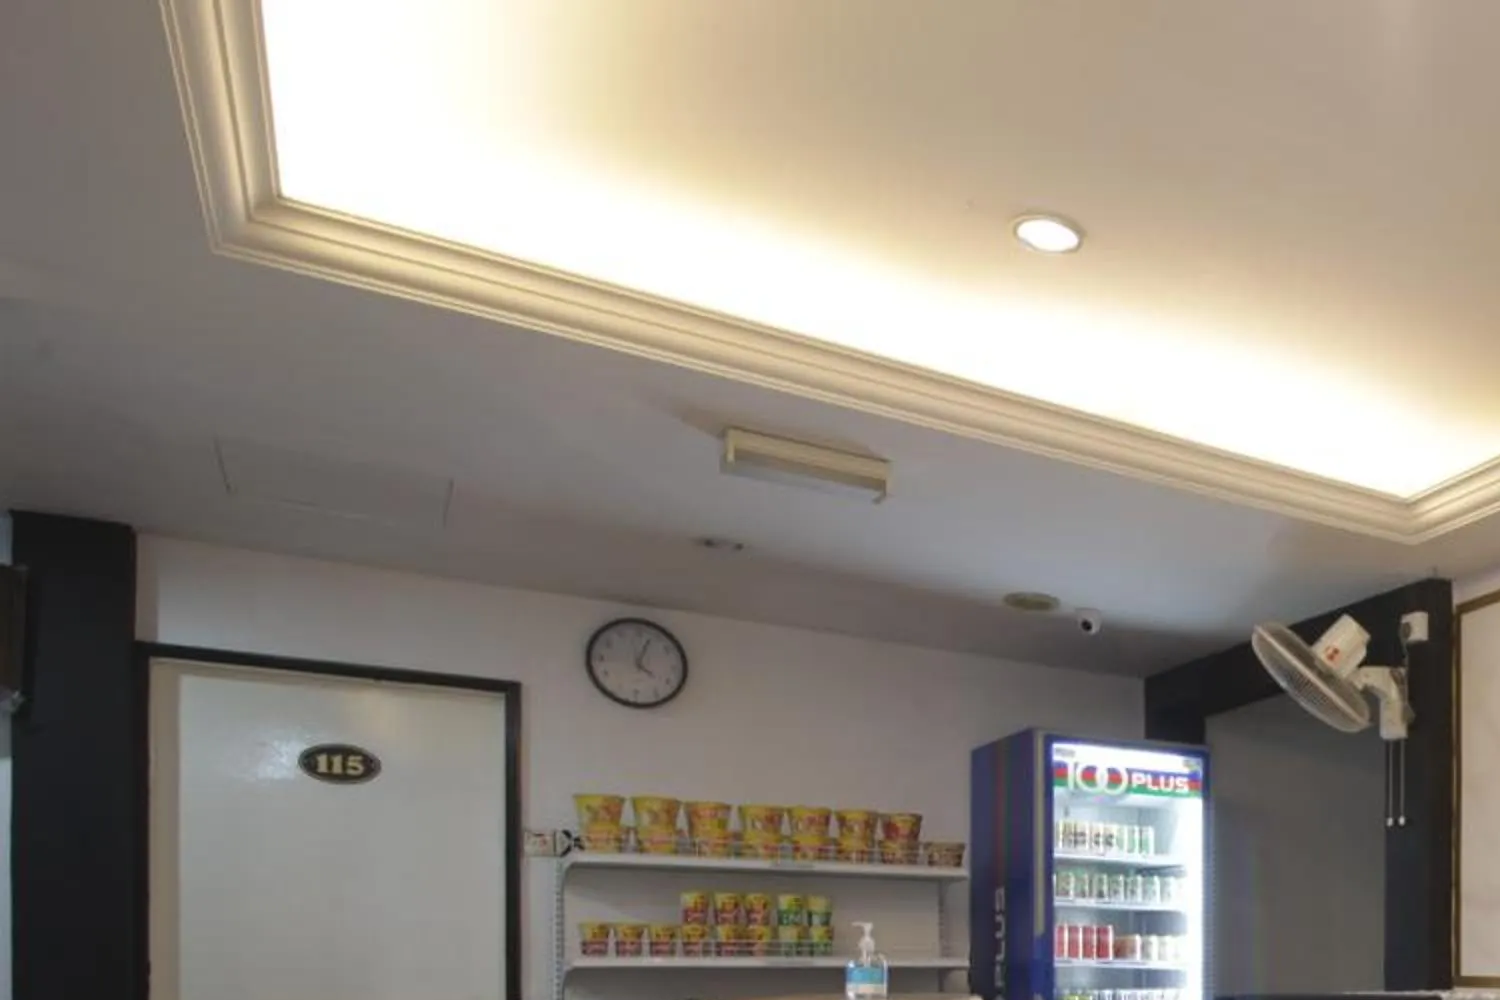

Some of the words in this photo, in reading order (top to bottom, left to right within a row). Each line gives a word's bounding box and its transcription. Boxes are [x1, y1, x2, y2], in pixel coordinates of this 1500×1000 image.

[316, 753, 364, 776] 115
[1058, 759, 1128, 796] 100
[1131, 772, 1190, 793] PLUS
